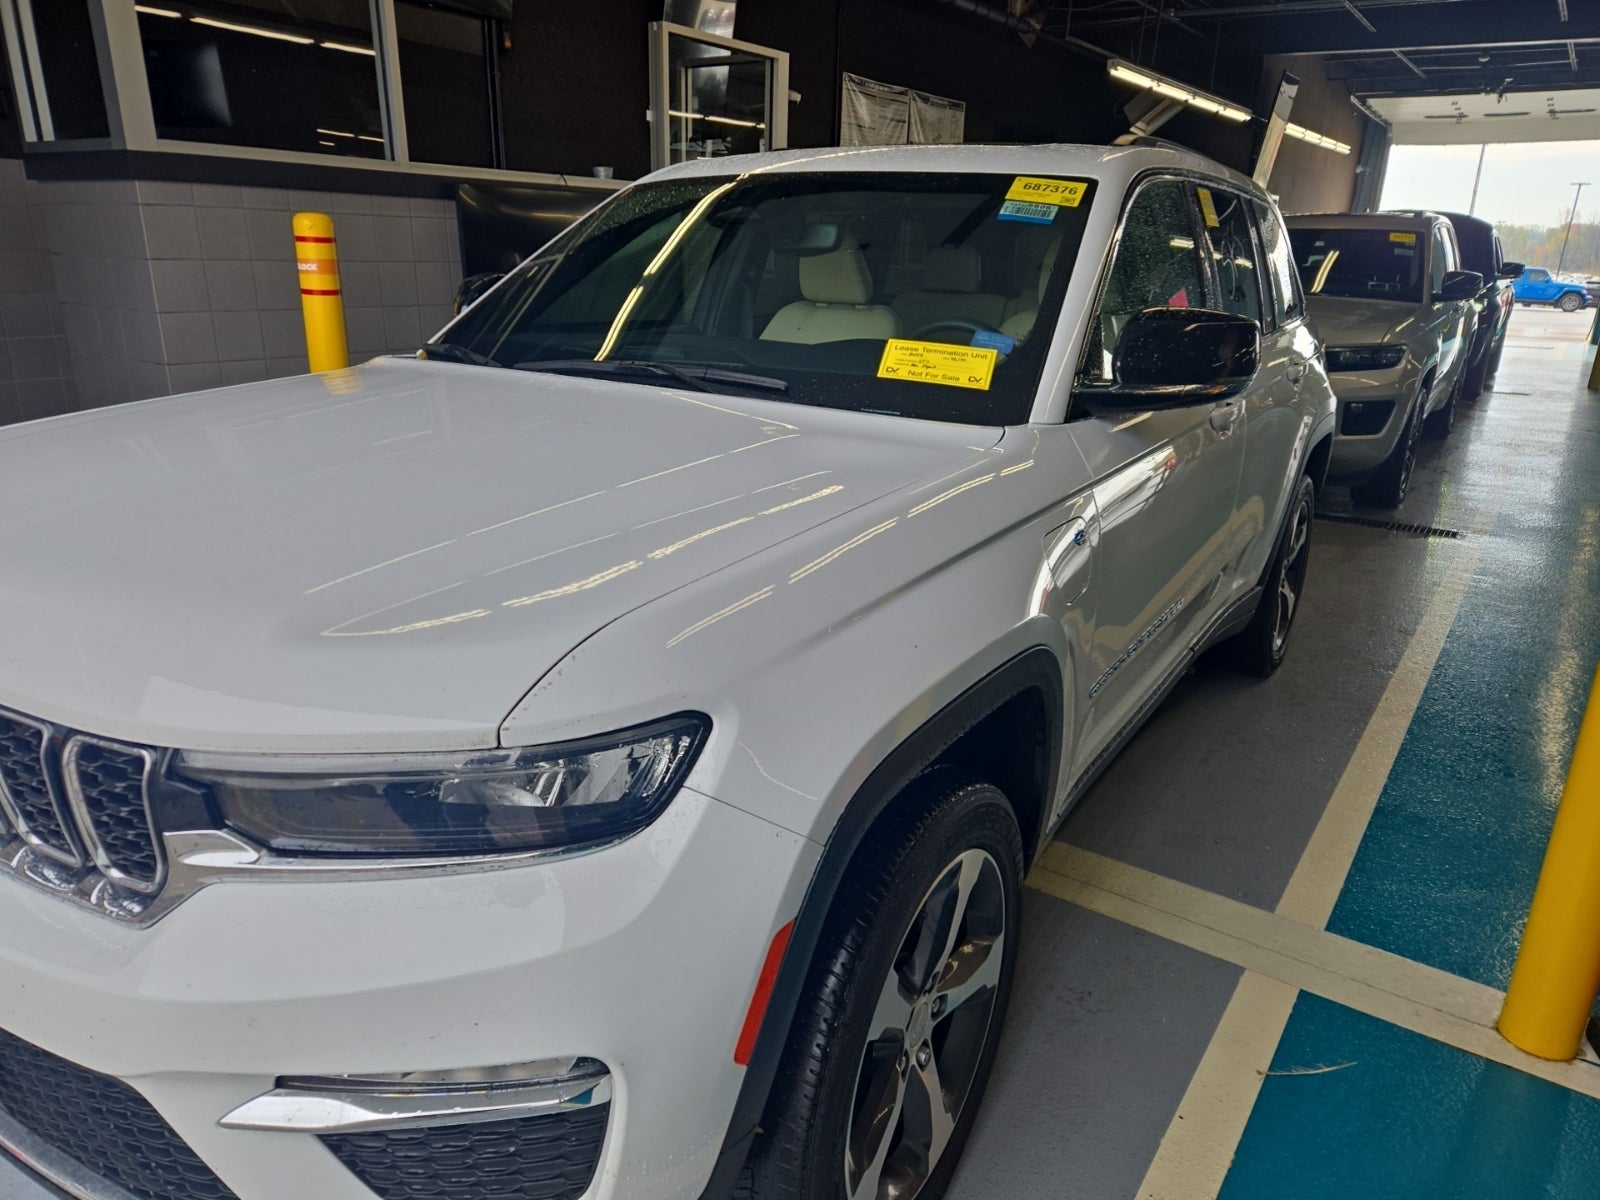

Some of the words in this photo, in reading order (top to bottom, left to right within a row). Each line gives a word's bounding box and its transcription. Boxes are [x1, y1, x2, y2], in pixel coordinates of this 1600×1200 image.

[1023, 182, 1078, 195] 687376
[894, 344, 919, 353] Lease
[922, 345, 968, 358] Termination
[971, 352, 988, 360] Unit
[907, 369, 923, 377] Not
[925, 371, 939, 379] For
[941, 373, 961, 382] Sale
